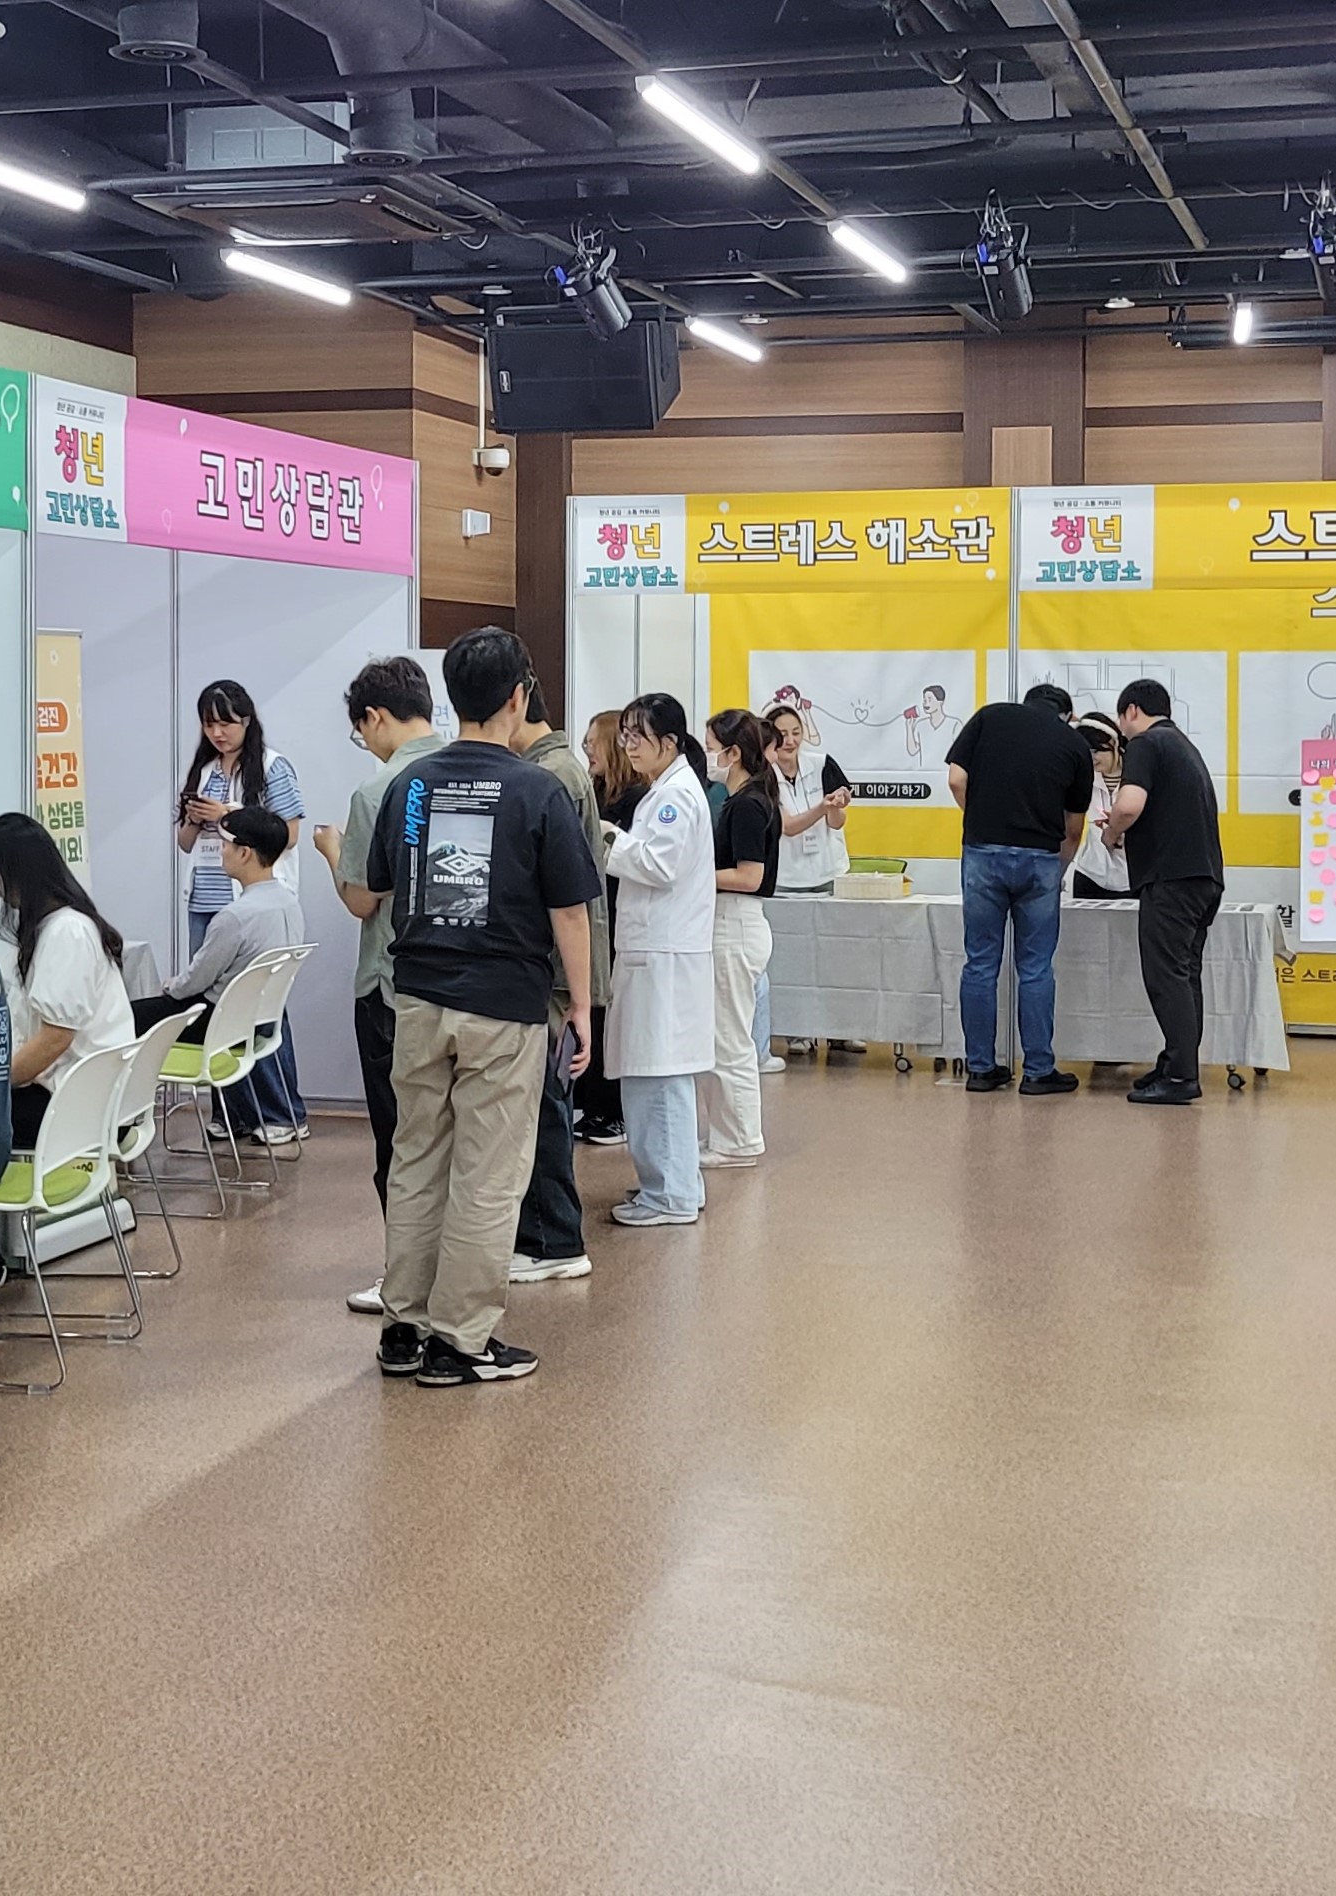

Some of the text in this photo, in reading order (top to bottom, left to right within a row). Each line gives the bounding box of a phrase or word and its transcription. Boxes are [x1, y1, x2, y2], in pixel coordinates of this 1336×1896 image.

[55, 424, 104, 486] 청년
[46, 491, 120, 529] 고민상담소
[197, 450, 364, 544] 고민상담관
[597, 523, 661, 561] 청년
[698, 516, 994, 566] 스트레스 해소관
[1050, 514, 1122, 555] 청년
[583, 566, 679, 588] 고민상담소
[1036, 560, 1142, 582] 고민상담소
[866, 784, 925, 797] 이야기하기
[404, 778, 429, 846] UMBRO
[433, 874, 484, 886] UMBRO
